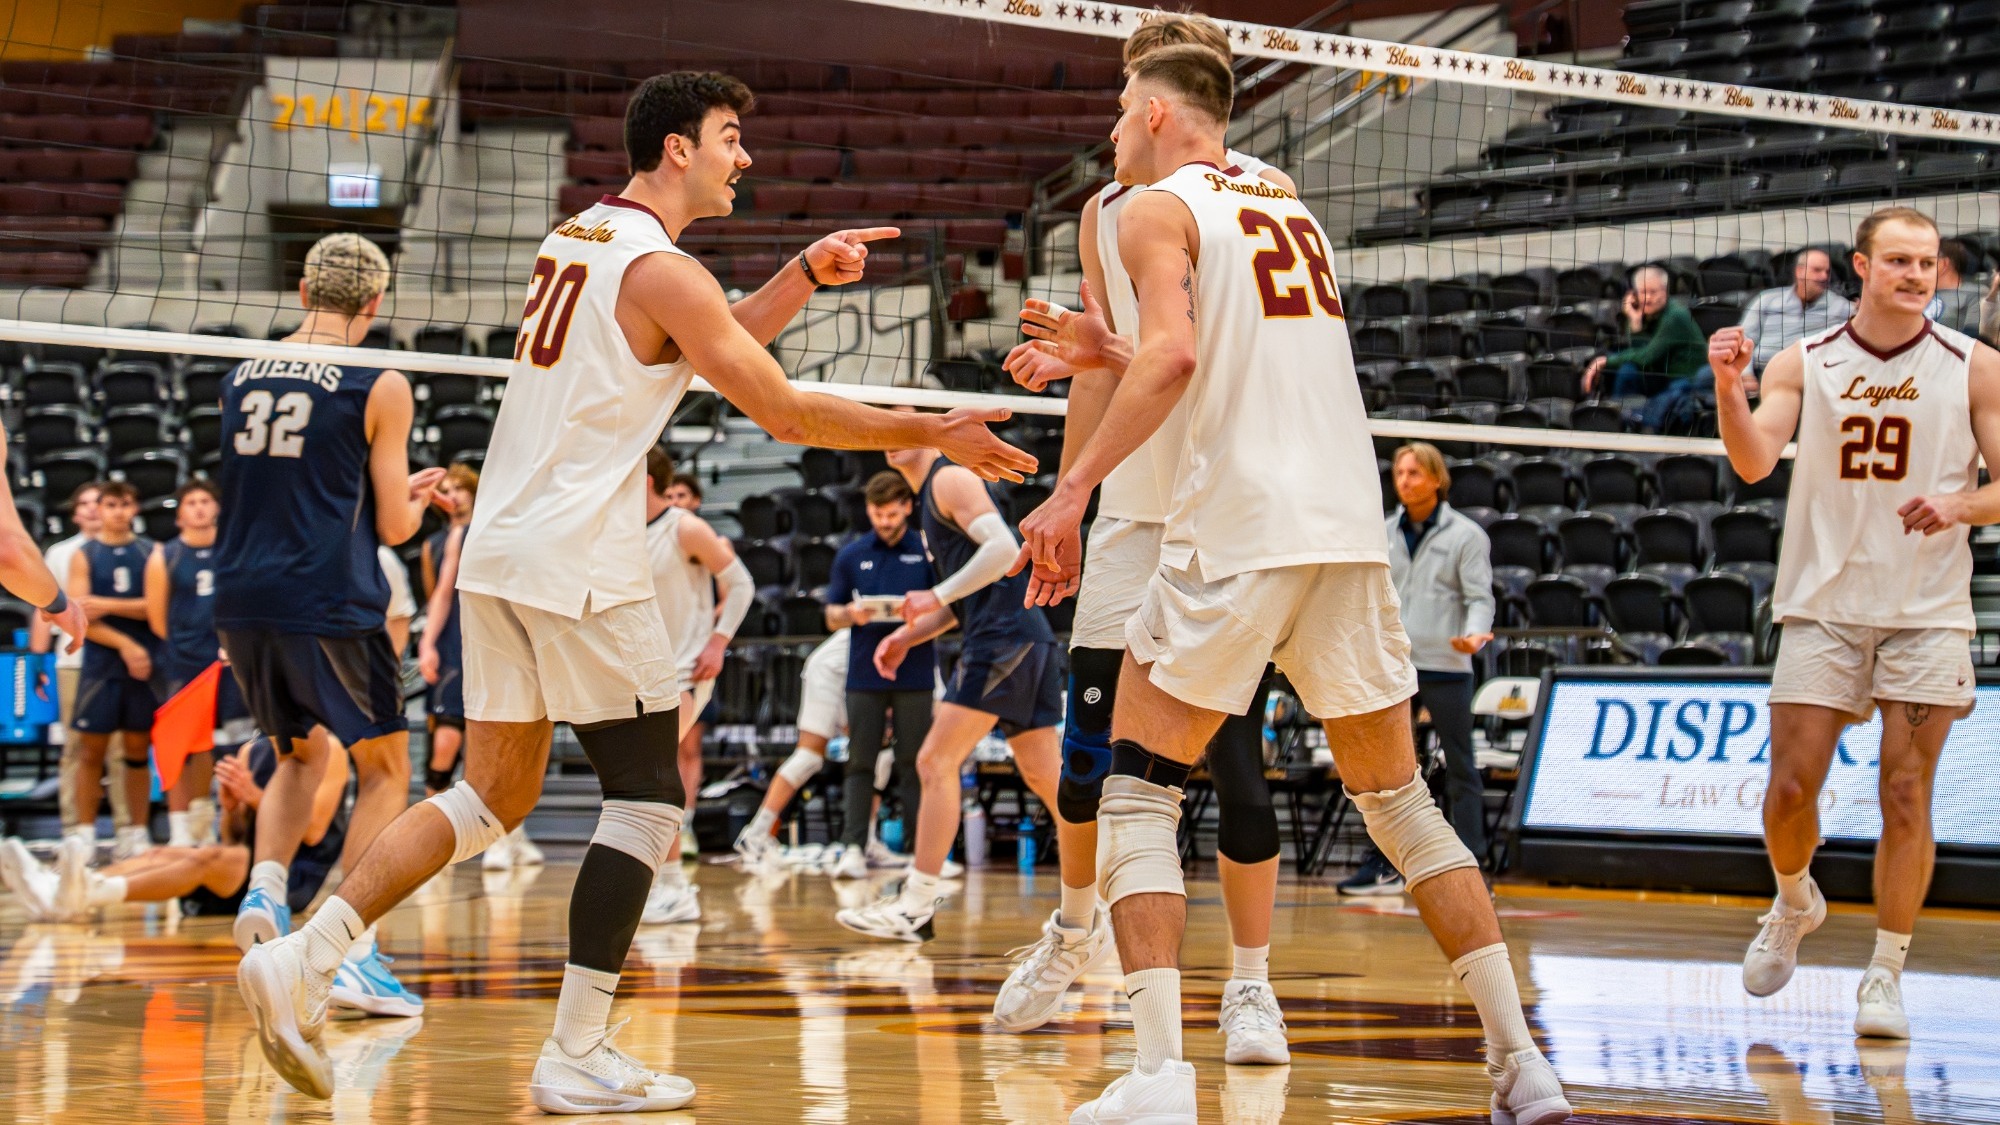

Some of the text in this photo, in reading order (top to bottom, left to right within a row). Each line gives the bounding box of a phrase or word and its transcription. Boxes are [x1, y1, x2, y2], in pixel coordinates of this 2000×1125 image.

[1236, 206, 1344, 321] 28
[514, 255, 589, 370] 20
[233, 358, 343, 393] QUEENS
[1840, 375, 1920, 408] Loyola
[233, 389, 314, 459] 32
[1839, 415, 1912, 482] 29
[1659, 775, 1727, 808] Law
